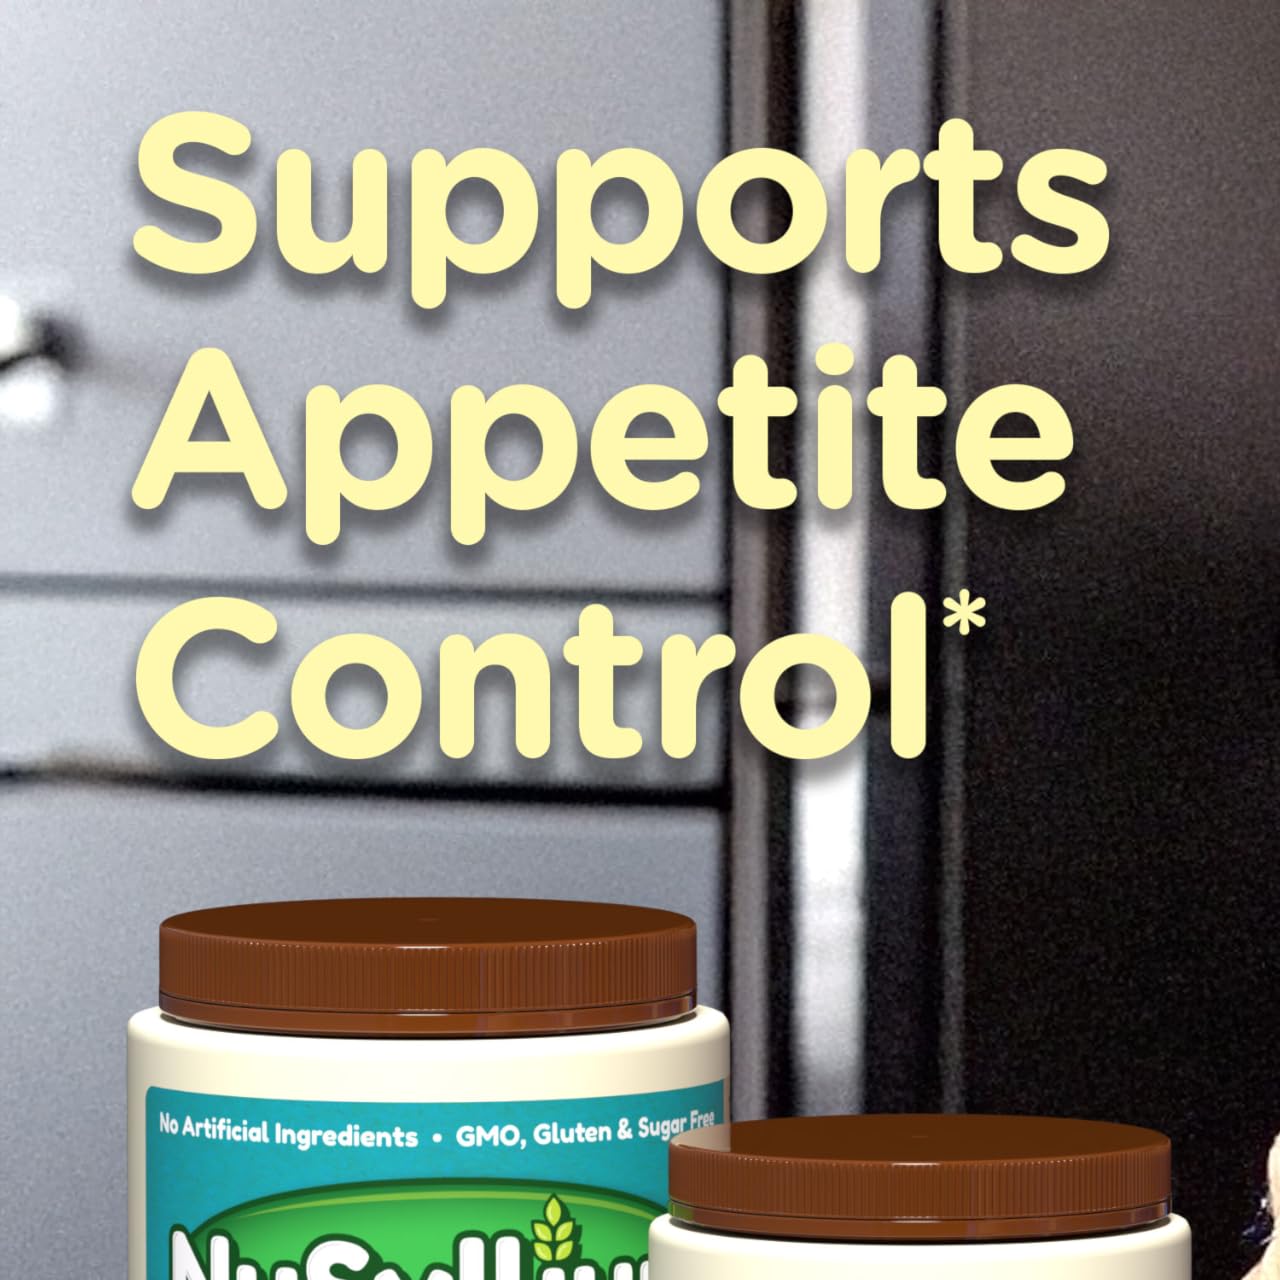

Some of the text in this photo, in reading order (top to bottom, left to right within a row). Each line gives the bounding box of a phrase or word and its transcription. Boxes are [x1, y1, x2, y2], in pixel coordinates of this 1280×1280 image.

[159, 1112, 179, 1135] No
[182, 1115, 270, 1143] Artificial
[275, 1122, 419, 1151] Ingredients
[455, 1124, 527, 1150] GMO,
[533, 1121, 612, 1145] Gluten
[617, 1117, 633, 1140] &
[638, 1116, 689, 1143] Sugar
